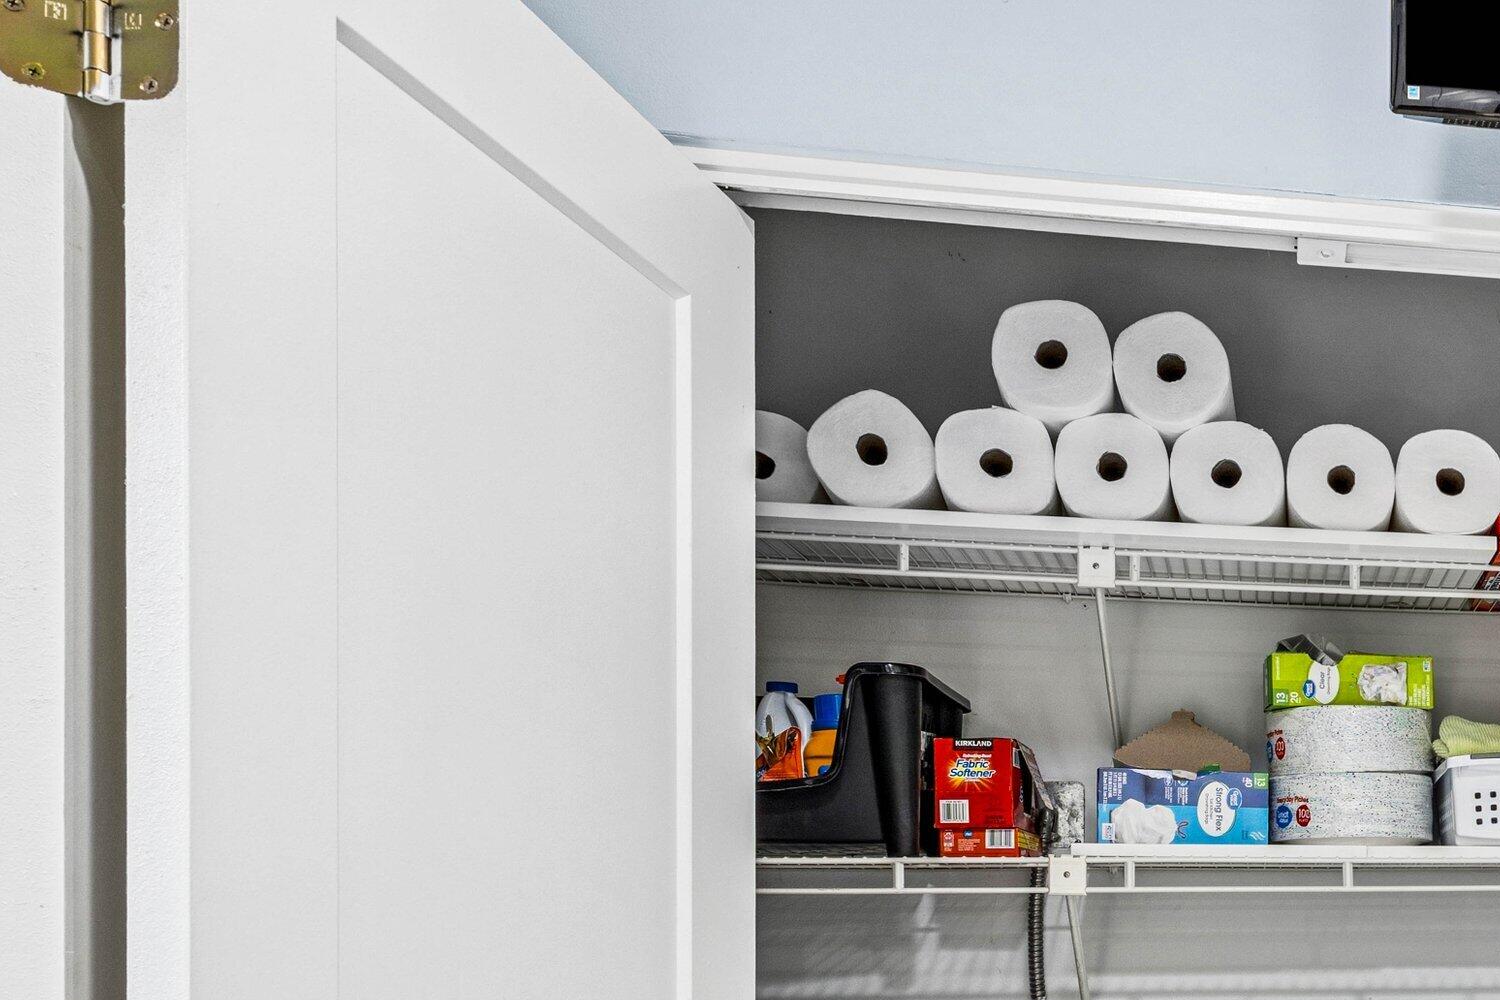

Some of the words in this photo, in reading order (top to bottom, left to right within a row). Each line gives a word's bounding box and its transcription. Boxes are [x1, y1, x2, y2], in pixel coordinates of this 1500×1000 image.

[1276, 692, 1285, 703] 13
[1290, 691, 1299, 703] 20
[956, 760, 989, 768] Fabric
[949, 769, 996, 777] Softener
[1245, 777, 1253, 788] 40
[1256, 778, 1266, 787] 13
[1214, 787, 1223, 813] Strong
[1298, 809, 1311, 818] 100
[1215, 815, 1223, 831] Flex
